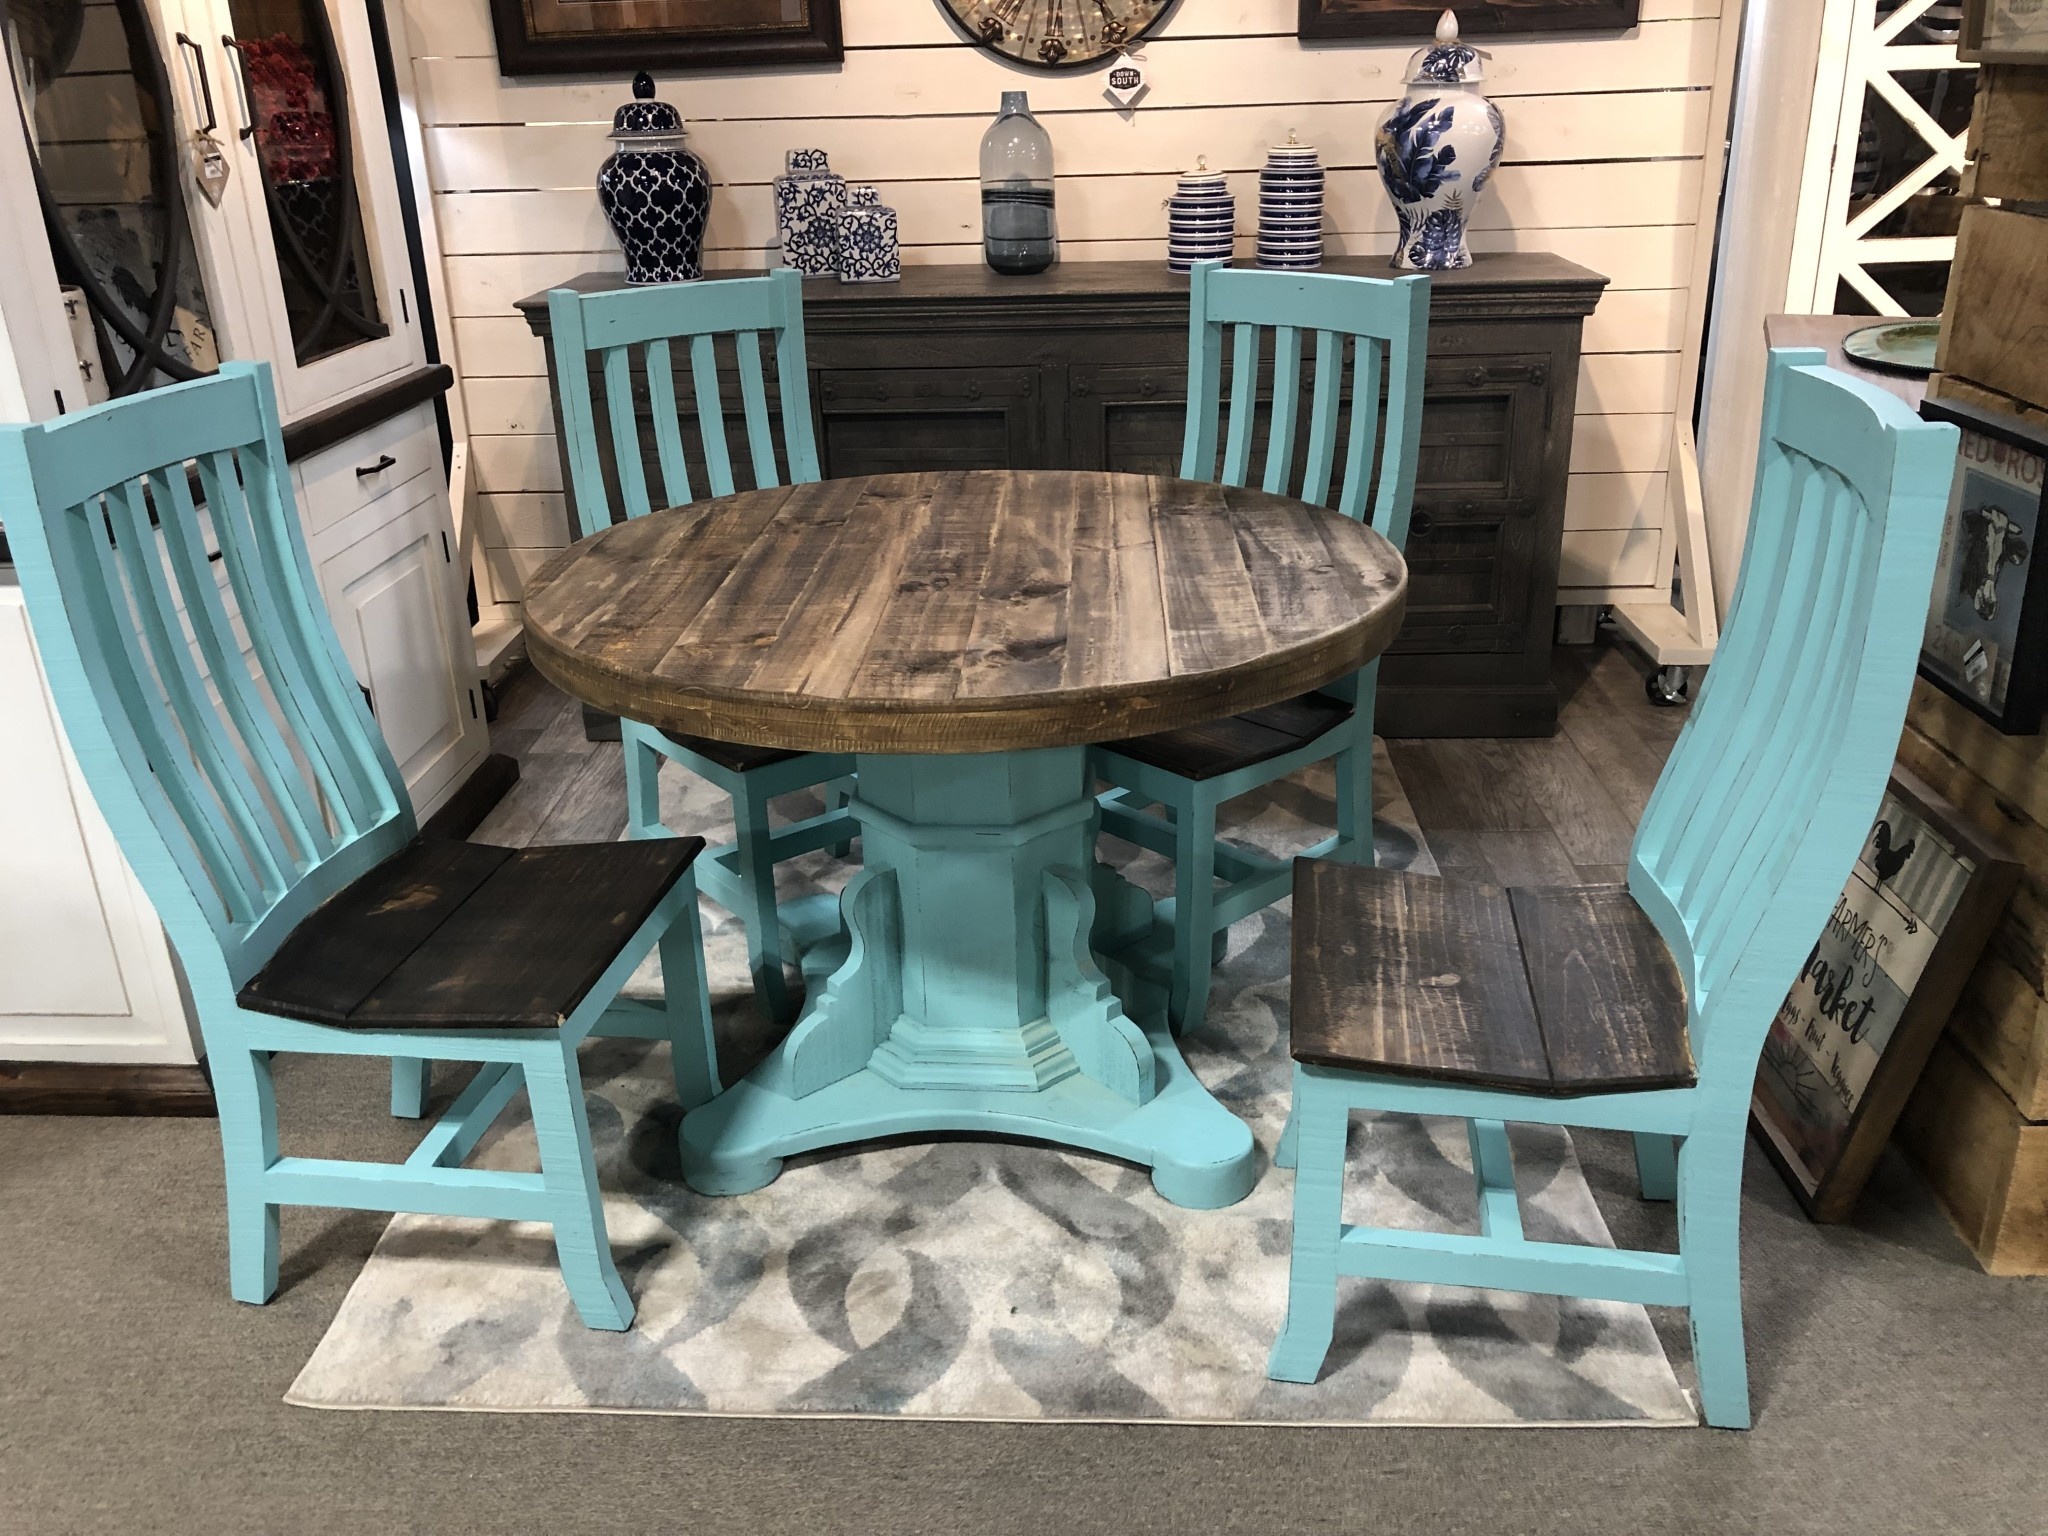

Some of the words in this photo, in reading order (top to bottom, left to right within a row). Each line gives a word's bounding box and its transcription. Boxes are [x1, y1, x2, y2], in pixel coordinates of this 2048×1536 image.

[1111, 76, 1139, 85] SOUTH
[1959, 428, 1990, 464] ED
[1827, 892, 1887, 988] ARMER'S
